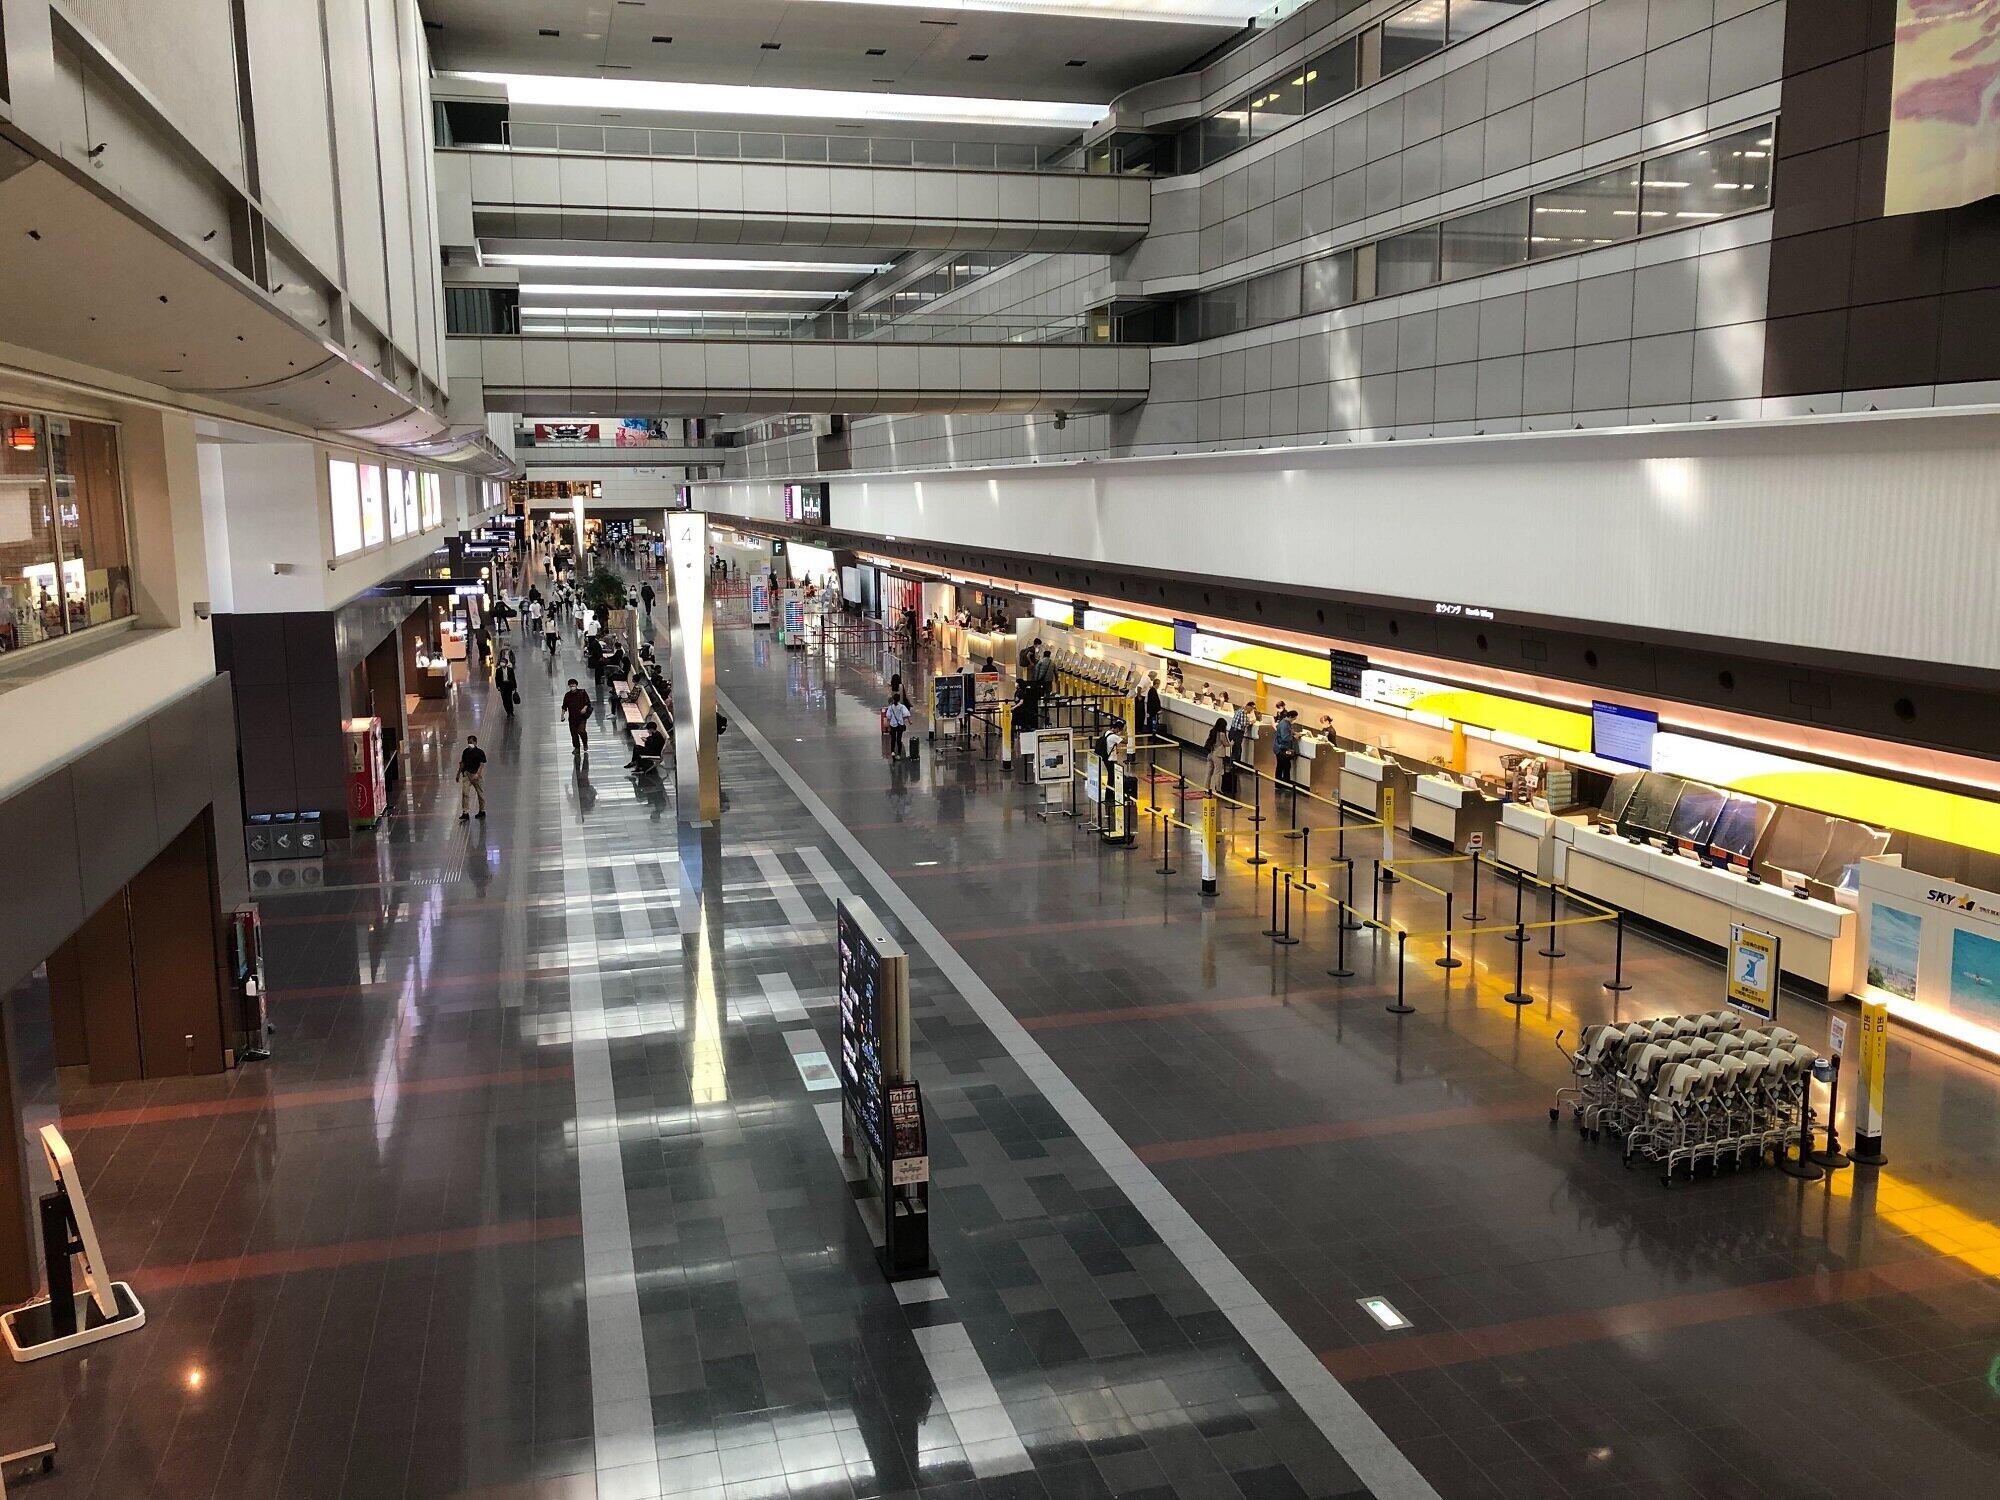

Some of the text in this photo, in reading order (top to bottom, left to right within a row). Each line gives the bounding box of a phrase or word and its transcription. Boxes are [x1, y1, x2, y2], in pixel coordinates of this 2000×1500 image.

[681, 527, 691, 542] 4
[775, 543, 782, 553] F
[1794, 887, 1809, 897] Closed
[1926, 889, 1956, 905] SKY
[1863, 1014, 1871, 1032] 出口
[1876, 1016, 1884, 1033] 出口
